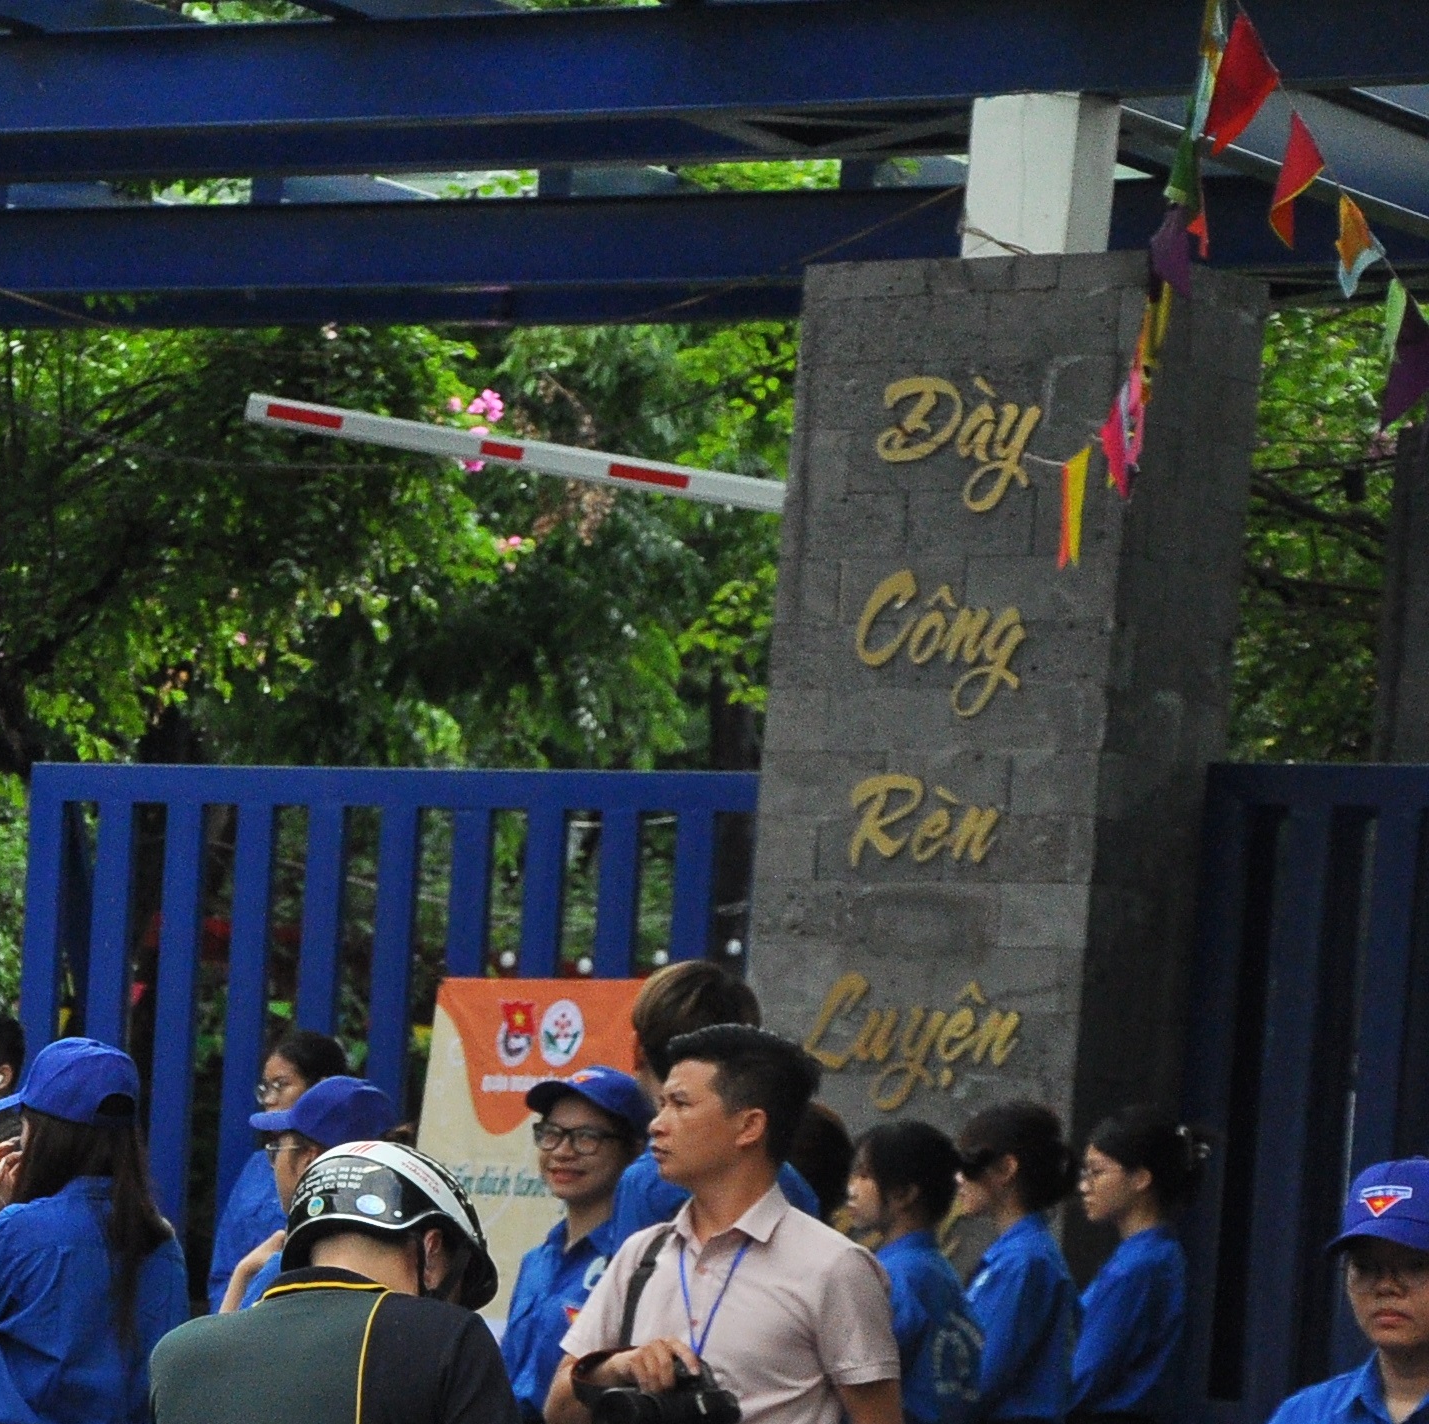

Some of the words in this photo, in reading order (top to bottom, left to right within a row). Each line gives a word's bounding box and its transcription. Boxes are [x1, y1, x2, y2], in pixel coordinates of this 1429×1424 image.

[856, 569, 1027, 718] Công
[849, 774, 999, 868] Rèn
[804, 970, 1022, 1112] Luyện
